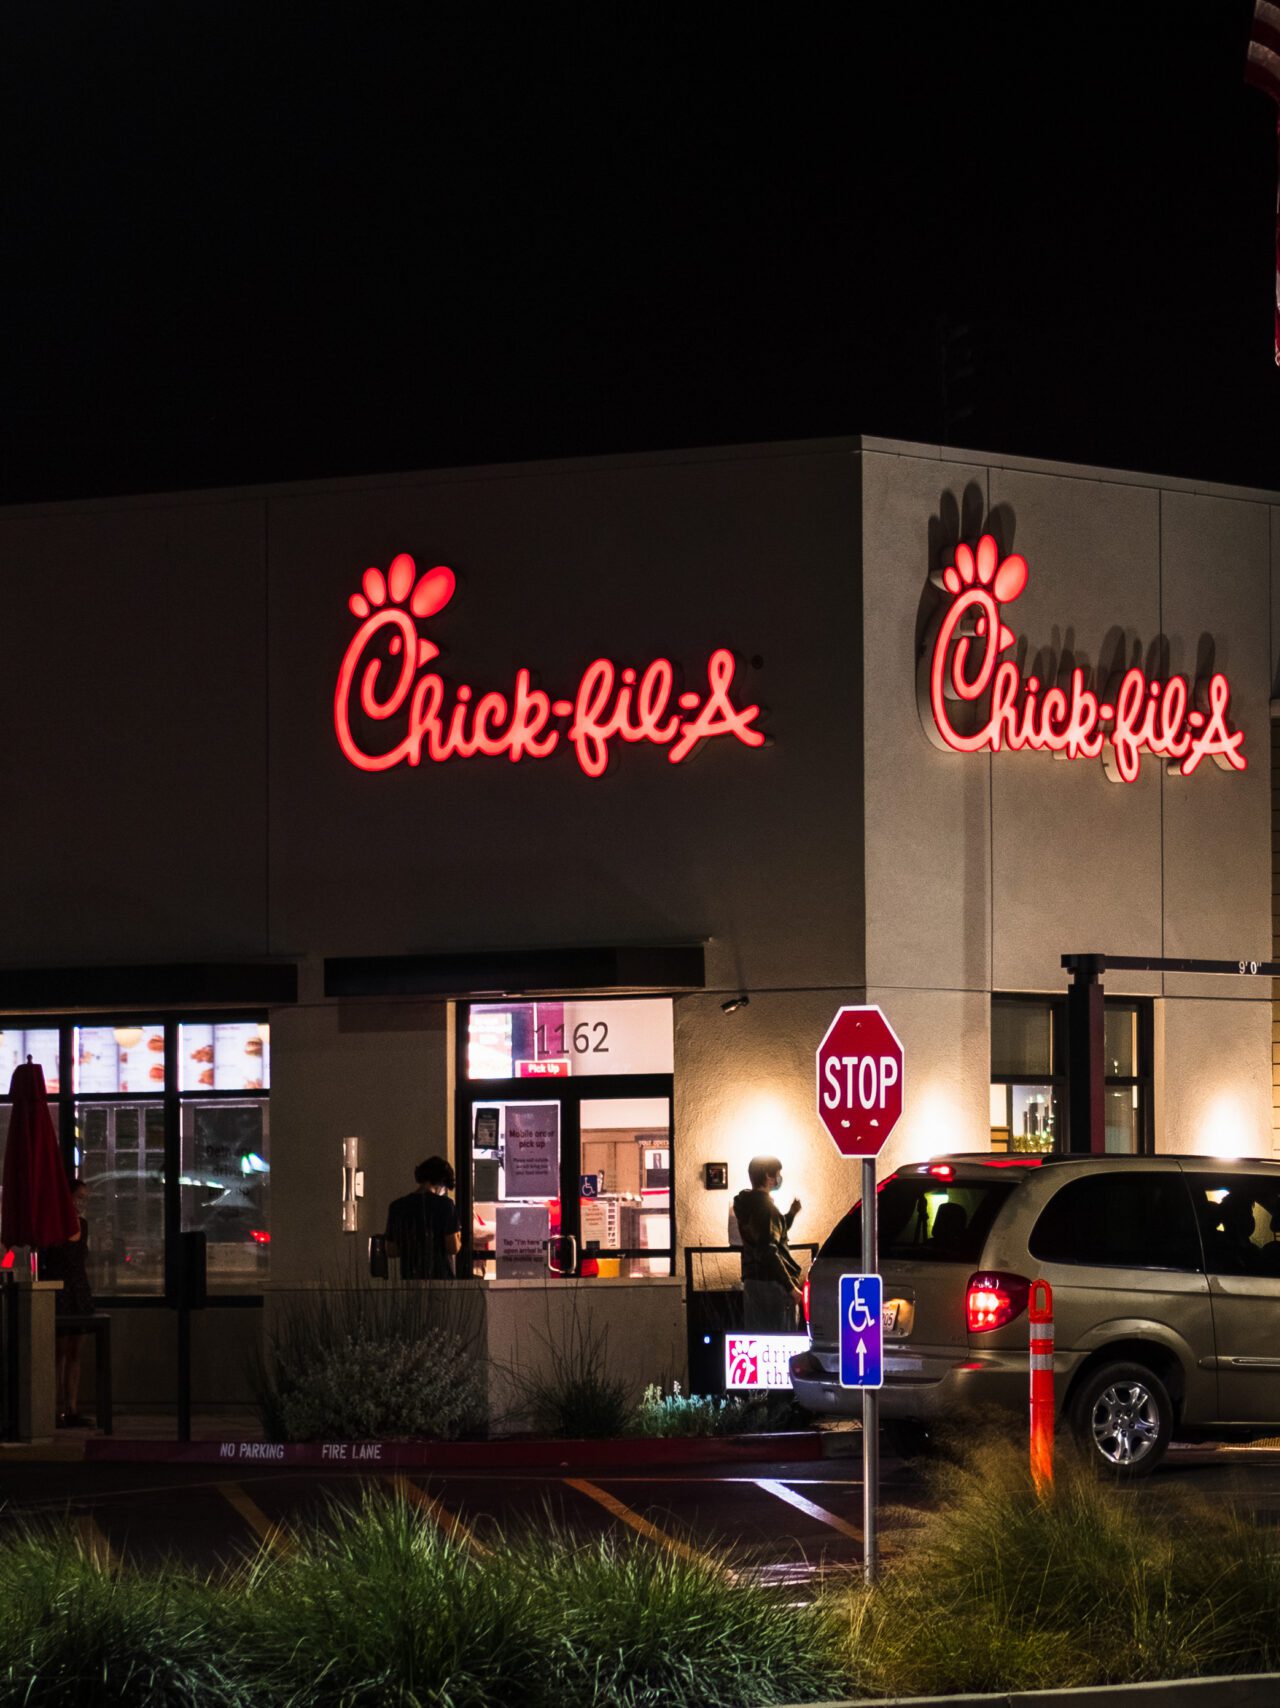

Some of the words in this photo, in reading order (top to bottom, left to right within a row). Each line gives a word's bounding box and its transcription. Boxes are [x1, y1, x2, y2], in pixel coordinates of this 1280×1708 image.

[334, 606, 766, 777] Chick-fil-A
[931, 587, 1247, 784] Chick-fil-A
[535, 1021, 609, 1055] 1162
[528, 1063, 546, 1074] Pick
[547, 1063, 560, 1075] Up
[823, 1055, 899, 1110] STOP
[509, 1129, 533, 1138] Mobile
[519, 1140, 534, 1149] pick
[536, 1141, 546, 1149] up
[766, 1366, 791, 1385] thr
[220, 1443, 235, 1458] NO
[239, 1443, 284, 1459] PARKING
[322, 1444, 347, 1459] FIRE
[352, 1444, 382, 1459] LANE
